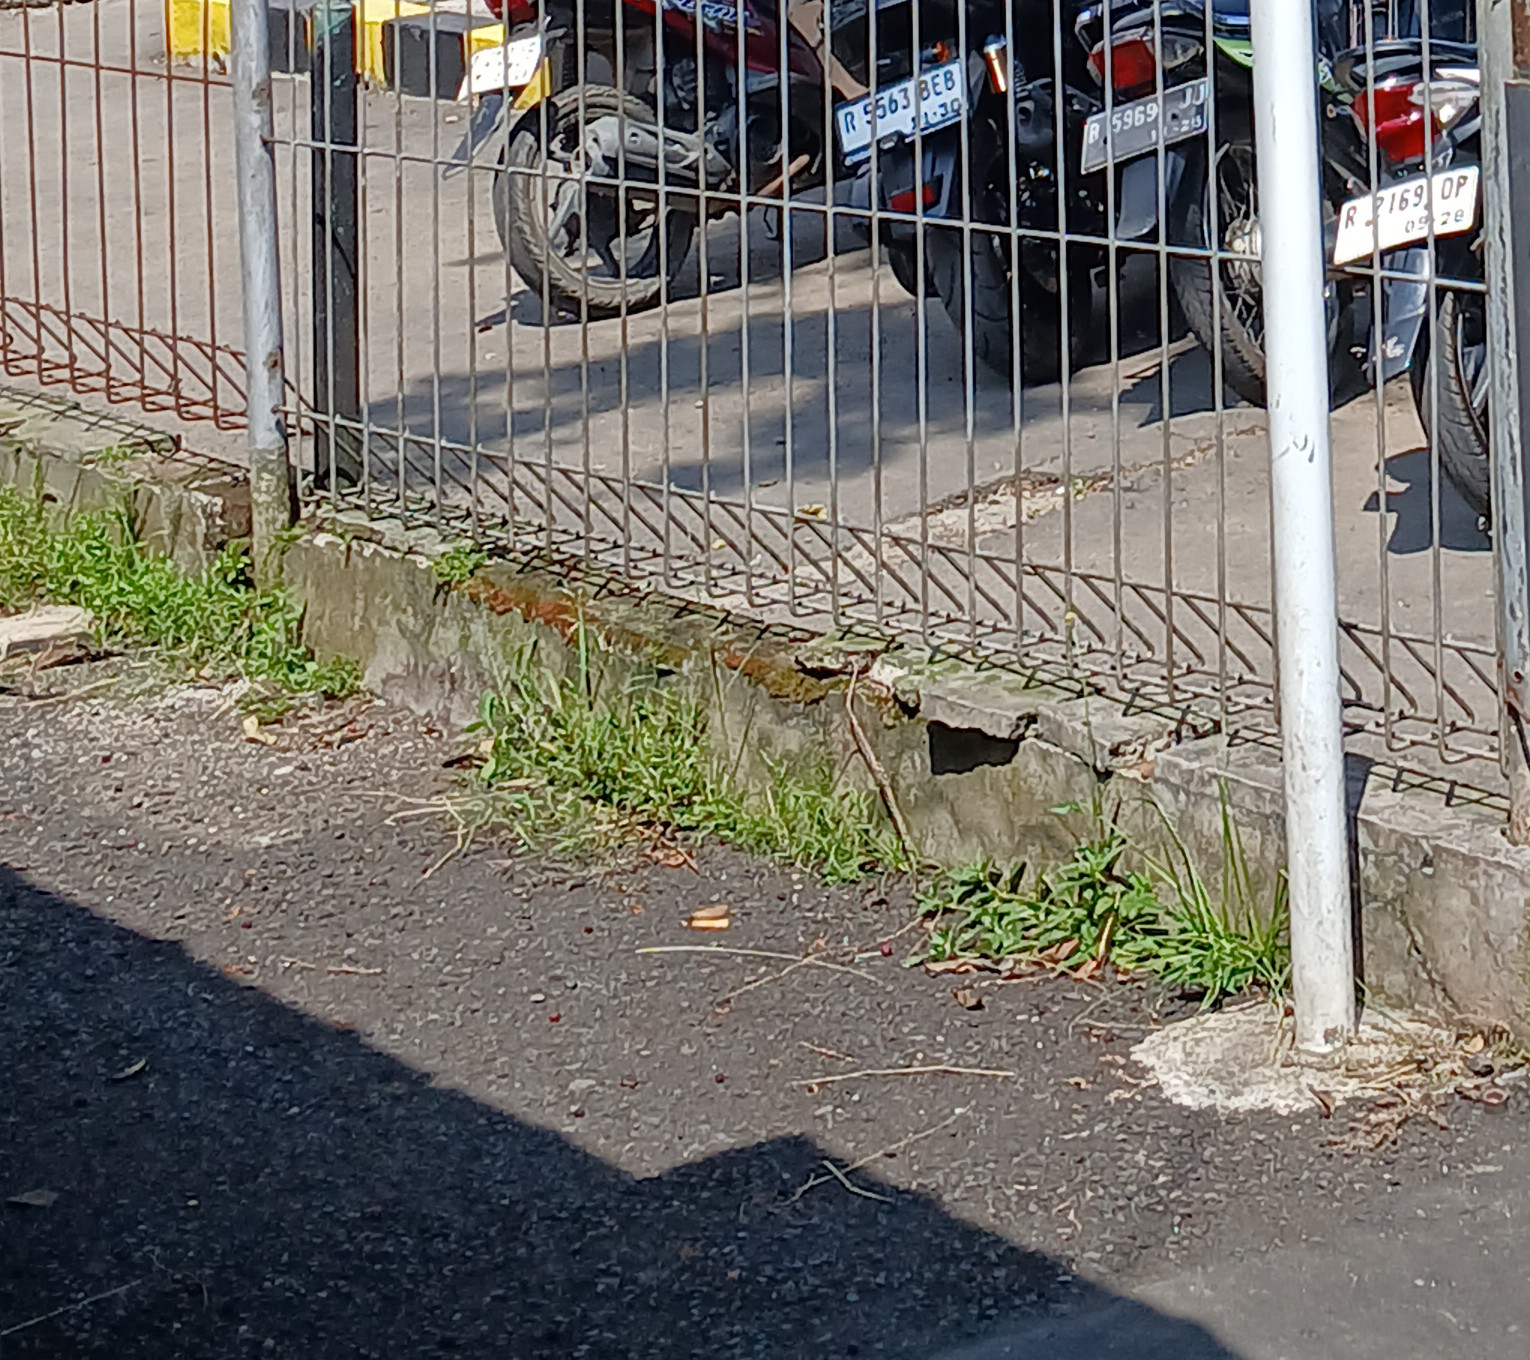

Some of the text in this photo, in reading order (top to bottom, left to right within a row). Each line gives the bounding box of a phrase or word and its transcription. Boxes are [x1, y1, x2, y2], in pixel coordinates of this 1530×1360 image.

[844, 110, 856, 134] R
[1112, 102, 1158, 133] 5969
[1345, 205, 1357, 229] R
